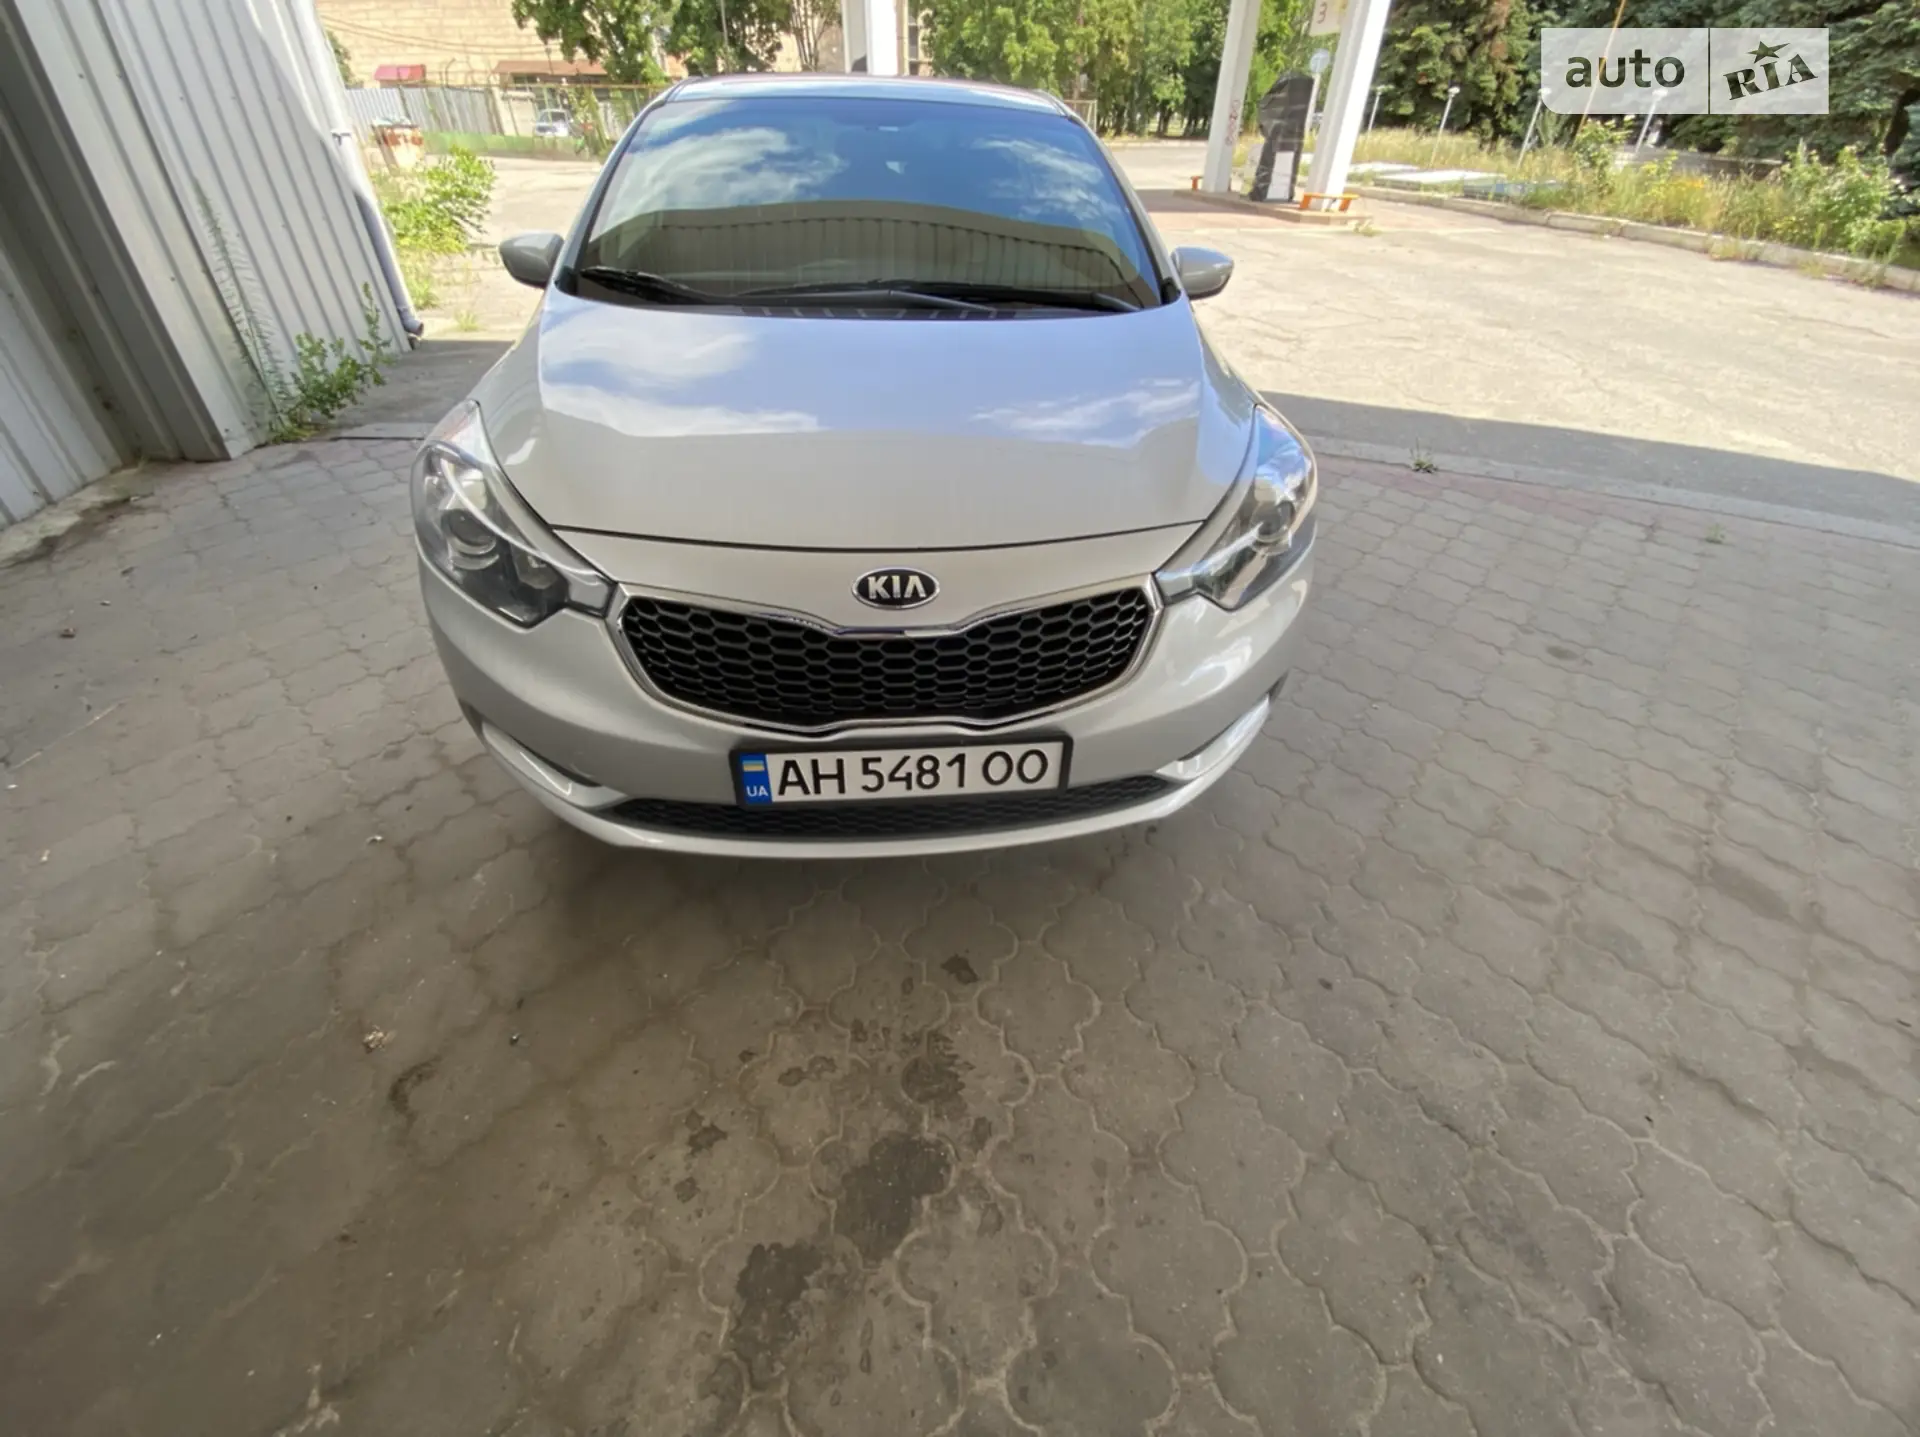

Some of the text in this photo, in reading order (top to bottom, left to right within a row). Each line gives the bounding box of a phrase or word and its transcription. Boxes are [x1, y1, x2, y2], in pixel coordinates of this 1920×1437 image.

[867, 575, 927, 599] KIA
[778, 758, 846, 796] AH
[860, 753, 967, 792] 5481
[746, 785, 768, 797] UA
